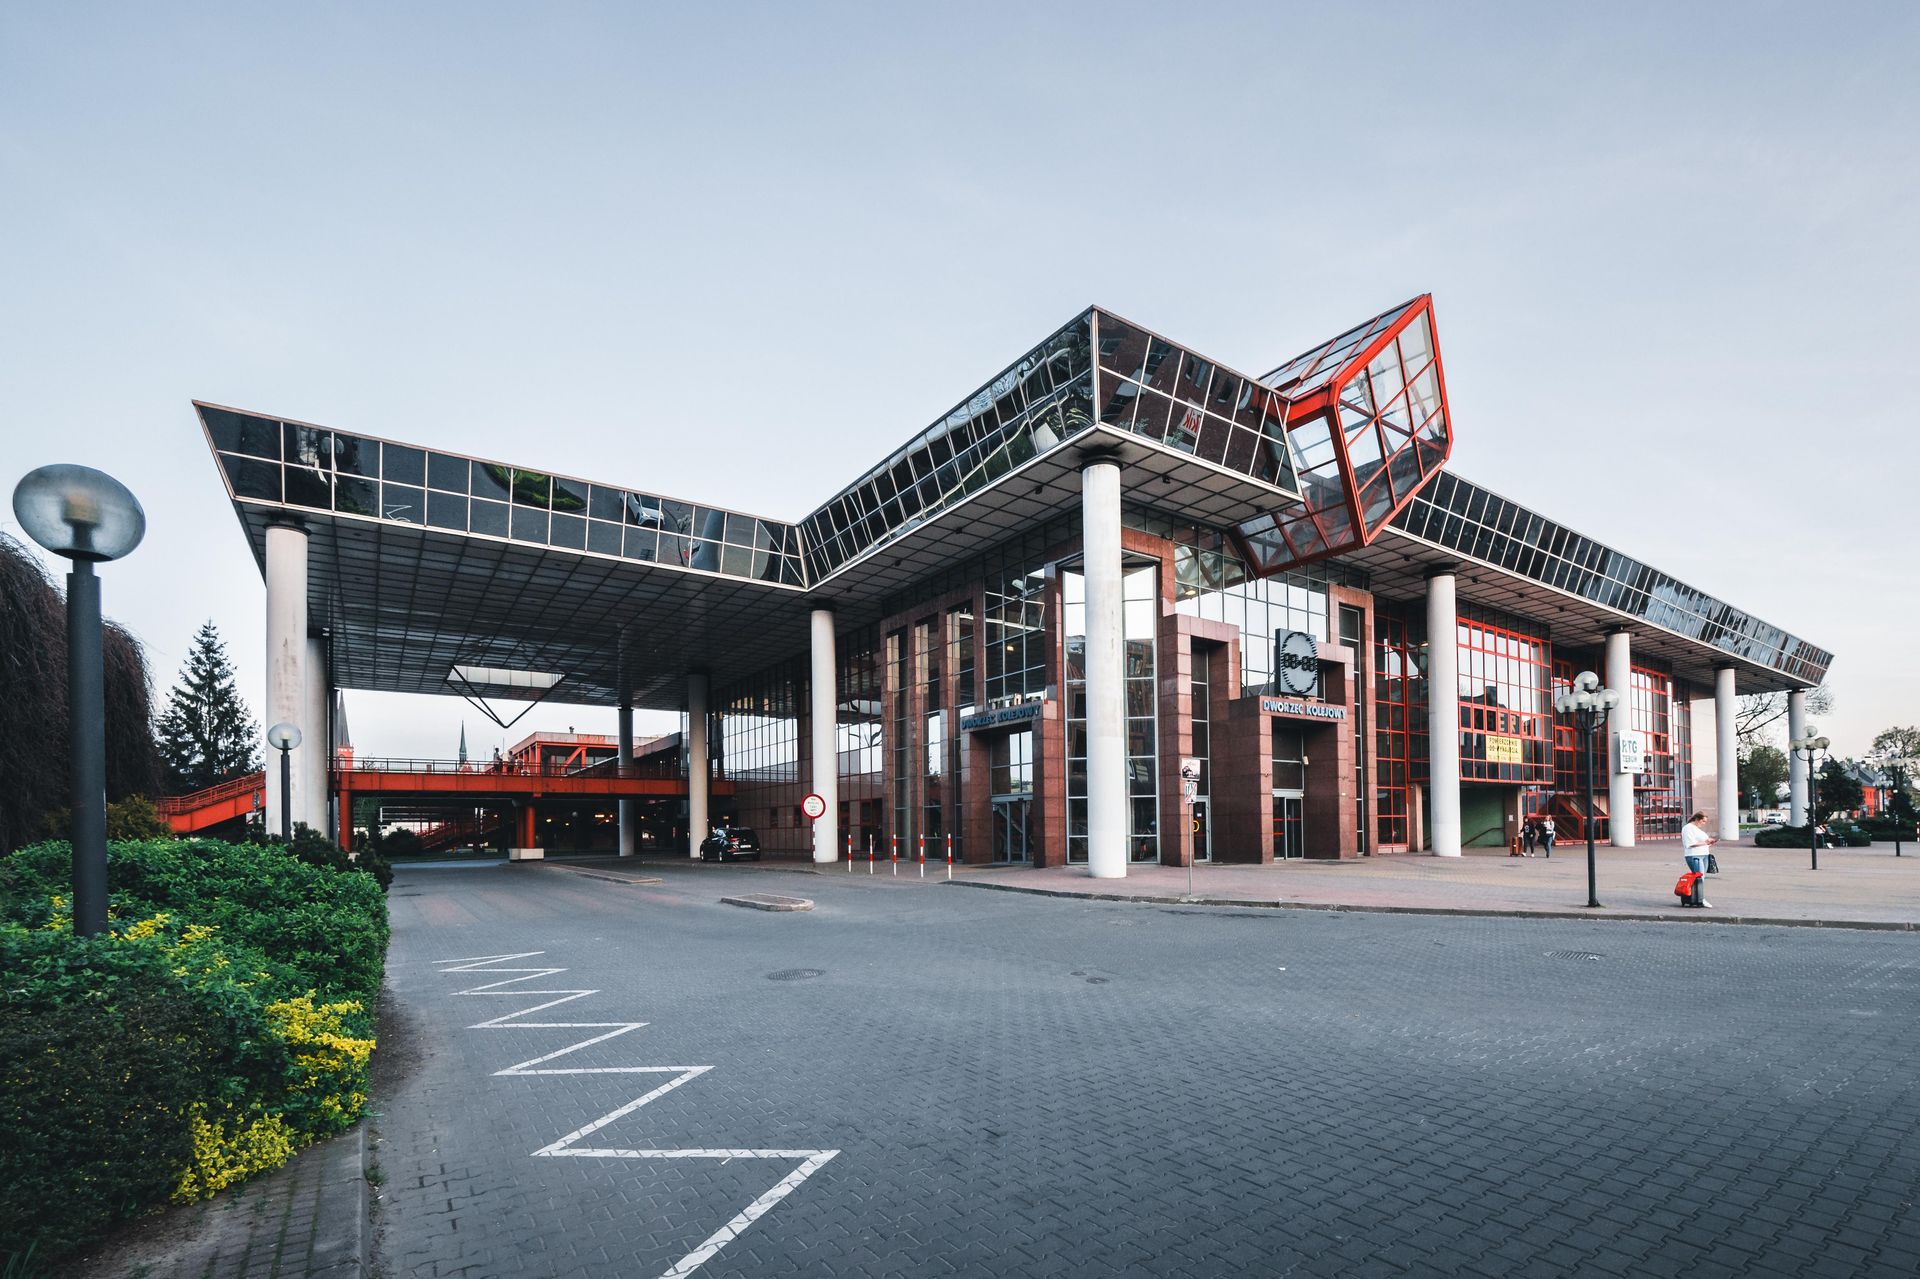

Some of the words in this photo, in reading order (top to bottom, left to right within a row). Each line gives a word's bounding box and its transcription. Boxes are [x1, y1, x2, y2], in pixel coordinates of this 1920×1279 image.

[962, 714, 996, 730] DWORZEC
[997, 705, 1040, 722] KOLEJOWY
[1263, 700, 1304, 714] DWORZEC
[1306, 704, 1346, 719] KOLEJOWY
[1622, 740, 1638, 753] RTG
